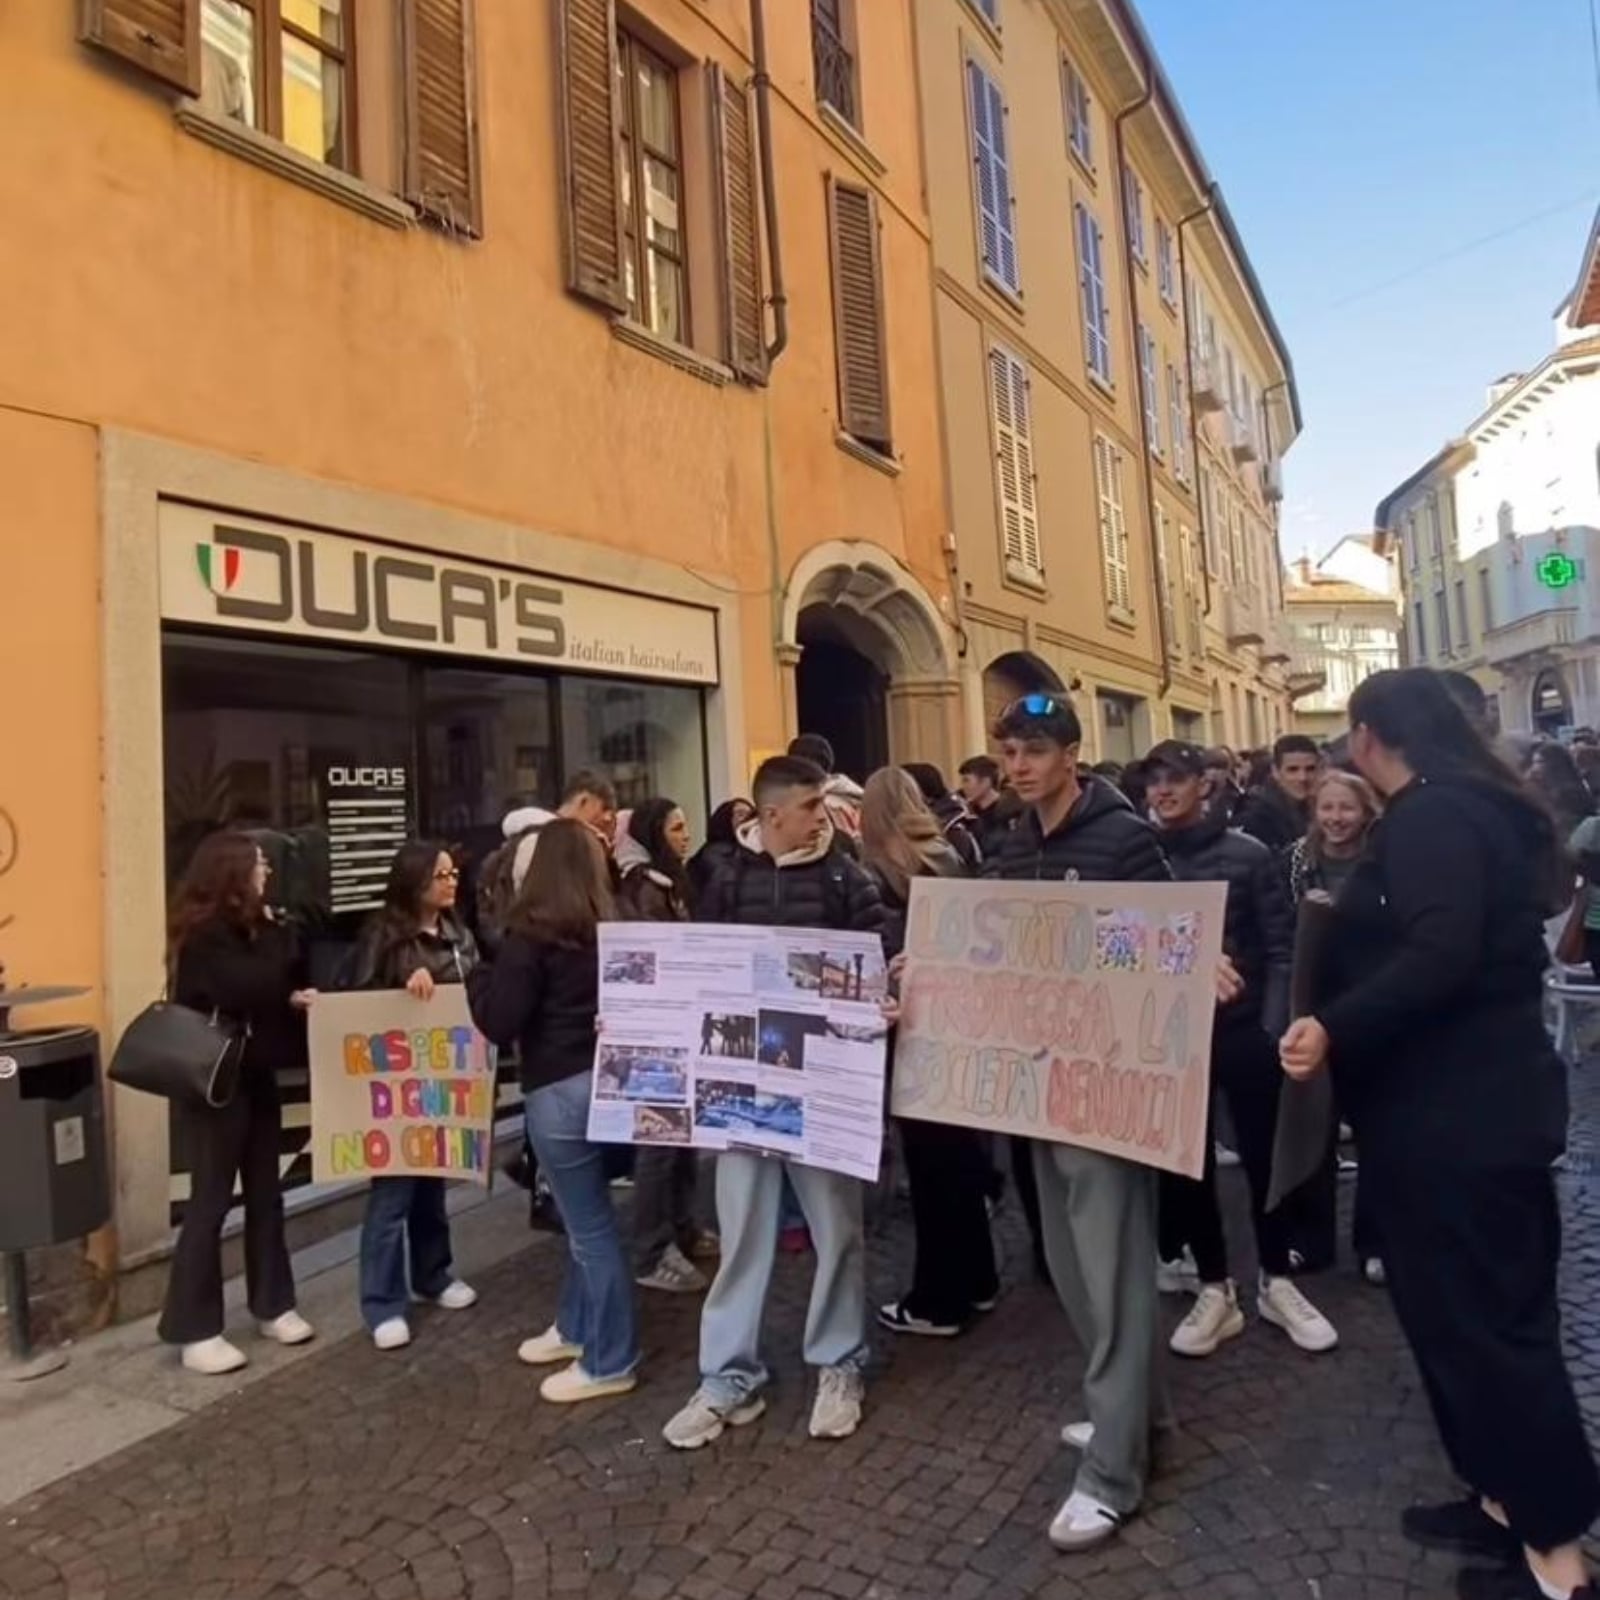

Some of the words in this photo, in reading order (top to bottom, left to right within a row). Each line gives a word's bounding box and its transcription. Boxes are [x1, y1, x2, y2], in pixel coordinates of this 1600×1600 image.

[196, 523, 566, 658] DUCA'S
[569, 635, 626, 666] italian
[968, 898, 1094, 974] STATO
[331, 1128, 391, 1174] NO
